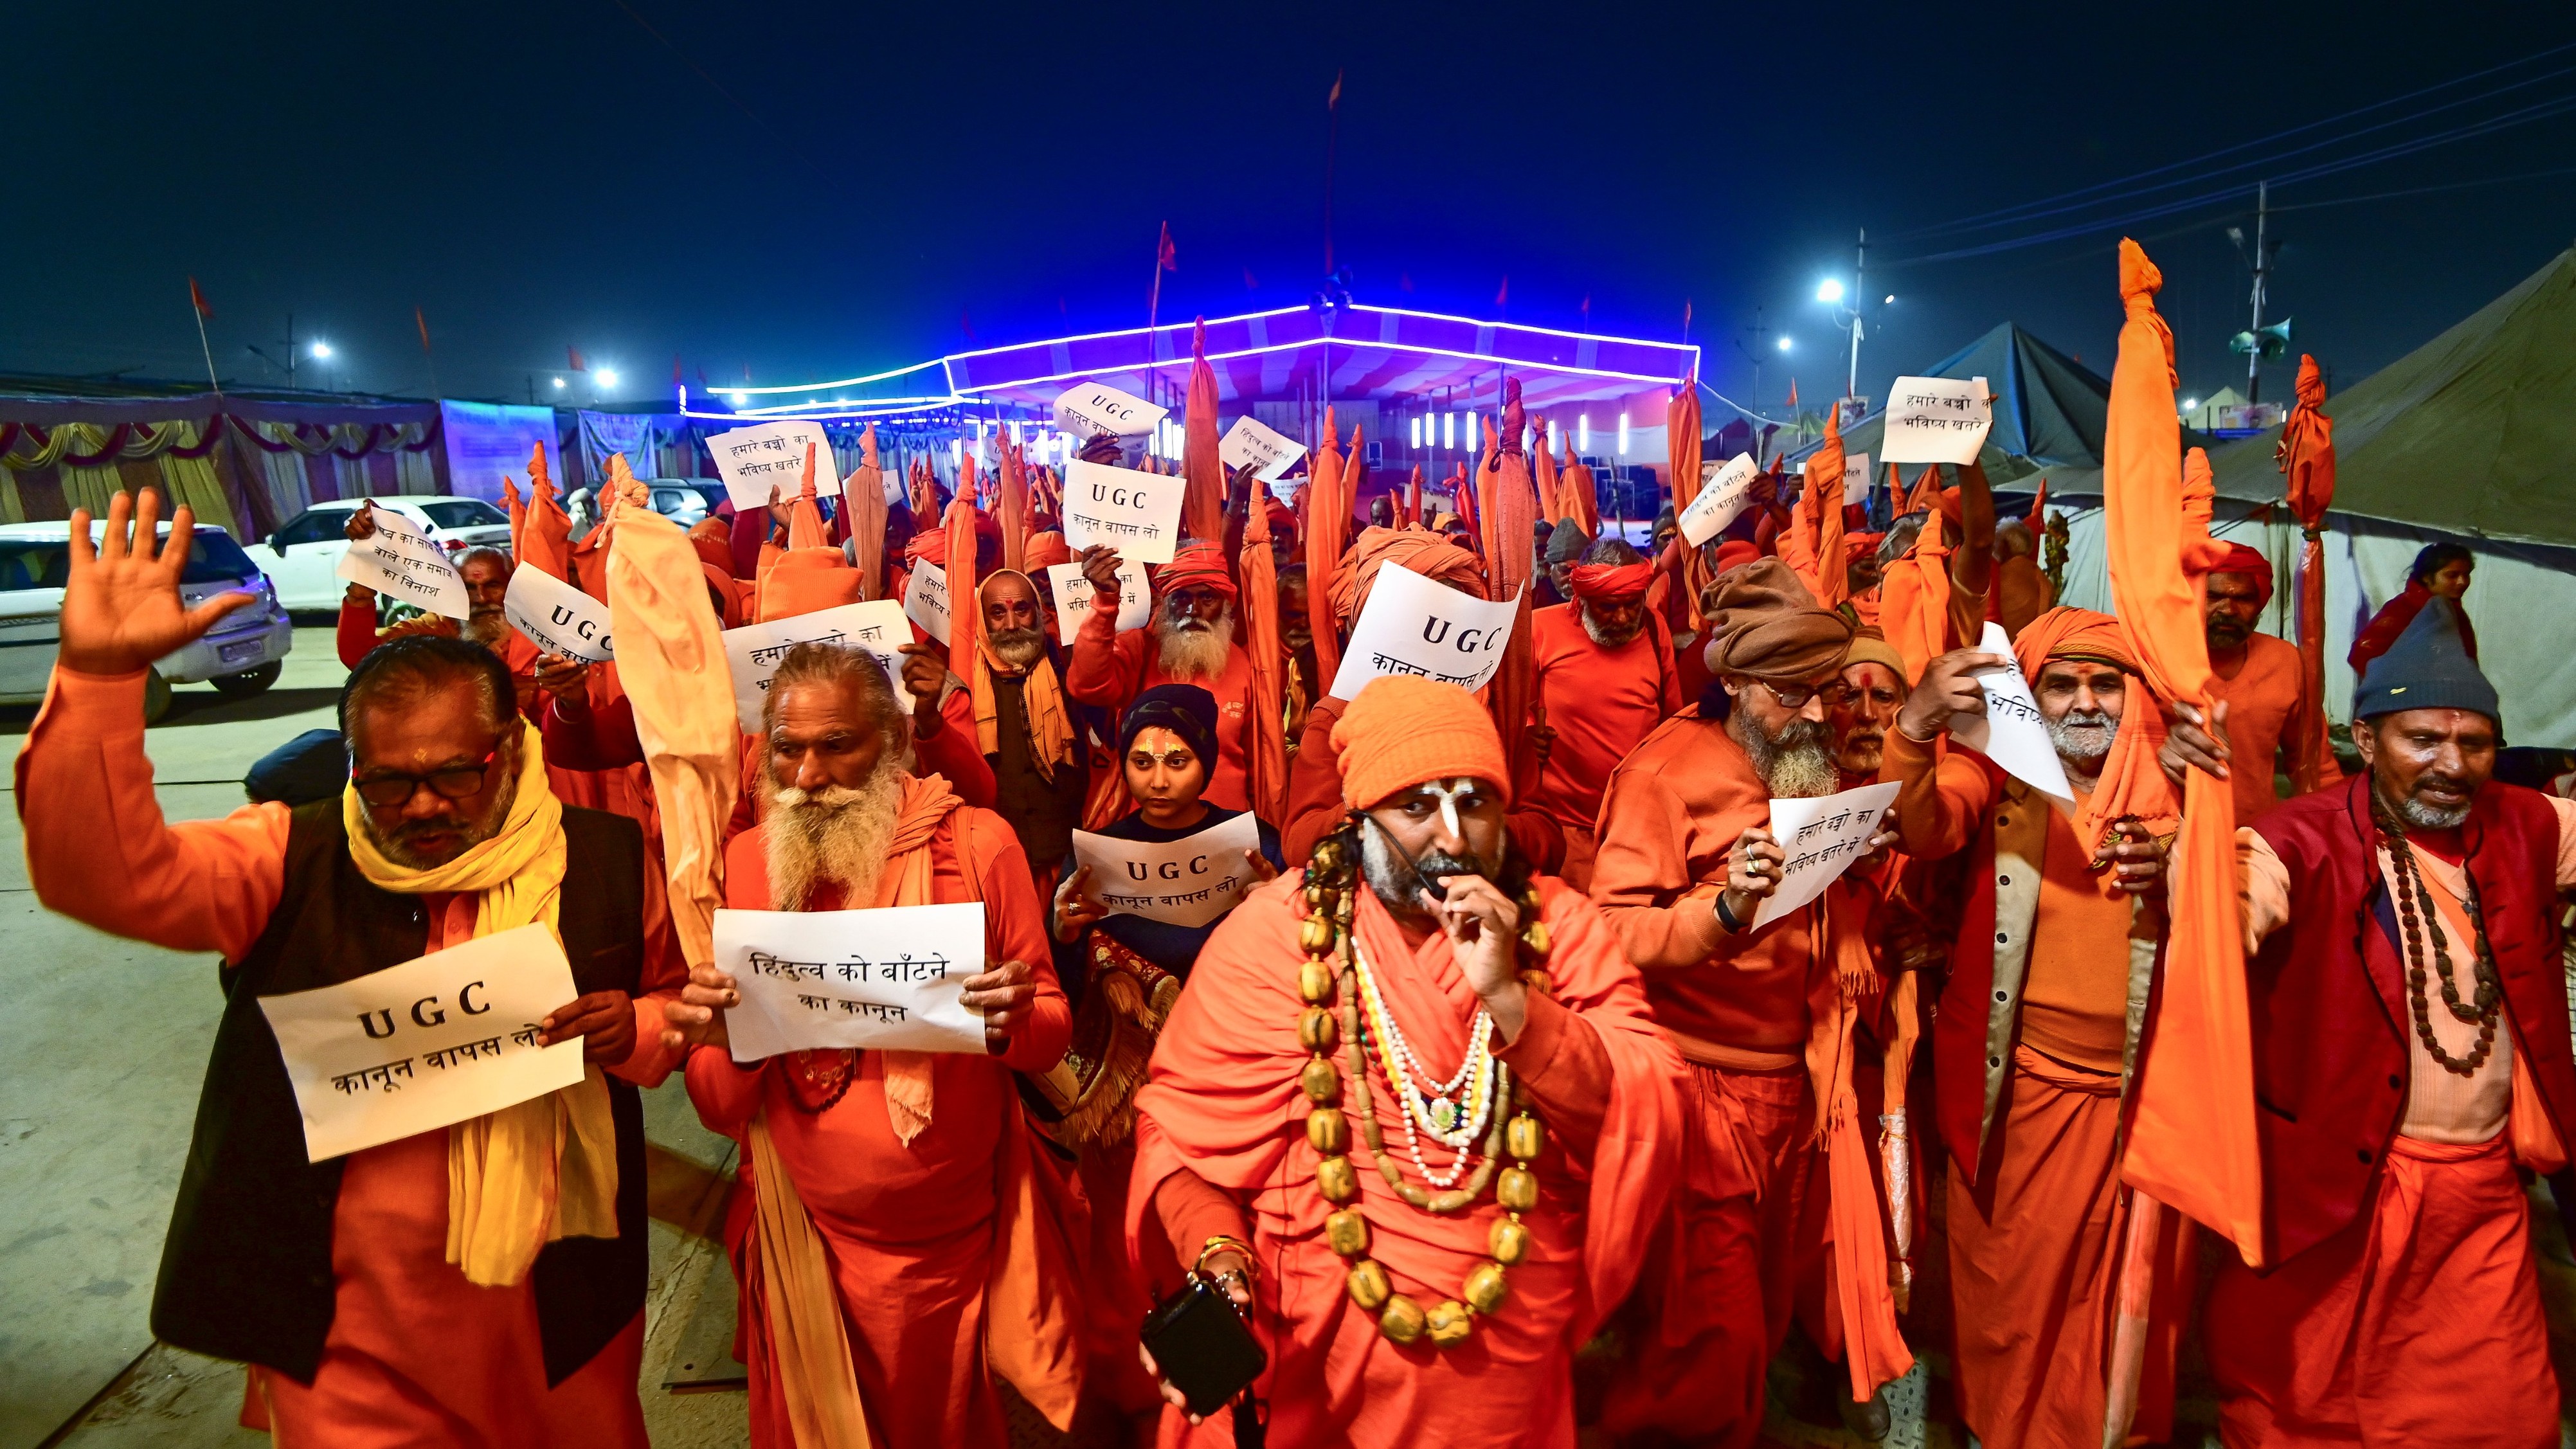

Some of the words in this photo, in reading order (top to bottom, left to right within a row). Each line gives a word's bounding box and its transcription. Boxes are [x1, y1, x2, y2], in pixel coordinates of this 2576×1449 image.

[1092, 395, 1133, 420] UGC
[1907, 392, 1939, 408] हमारे
[1064, 406, 1090, 427] कानून
[1904, 415, 1947, 430] भविष्य
[1952, 417, 1985, 431] खतरे
[730, 439, 760, 458] हमारे
[793, 435, 809, 445] का
[1243, 447, 1251, 456] का
[737, 463, 771, 477] भविष्य
[775, 455, 802, 470] खतरे
[1093, 484, 1146, 509] UGC
[1702, 507, 1715, 517] का
[1716, 494, 1740, 510] कानून
[399, 533, 415, 545] का
[1074, 514, 1101, 533] कानून
[1105, 521, 1139, 536] वापस
[1143, 524, 1160, 539] लो
[374, 546, 400, 562] वाले
[403, 557, 424, 570] एक
[383, 567, 398, 580] का
[400, 575, 440, 597] विनाश
[925, 575, 946, 595] हमारे
[919, 591, 945, 614] भविष्य
[1128, 592, 1136, 604] में
[519, 616, 557, 649] कानून
[858, 626, 883, 642] का
[1423, 615, 1502, 652] UGC
[1796, 816, 1827, 845] हमारे
[1857, 809, 1874, 825] का
[1126, 855, 1209, 881] UGC
[1785, 852, 1819, 876] भविष्य
[1820, 840, 1846, 862] खतरे
[1846, 836, 1860, 854] में
[1101, 893, 1153, 910] कानून
[1158, 888, 1210, 906] वापस
[1215, 876, 1239, 893] लो
[749, 951, 827, 982] हिंदुत्व
[836, 955, 872, 982] को
[880, 952, 950, 982] बाँटने
[356, 980, 491, 1040] UGC
[797, 994, 830, 1011] का
[838, 999, 908, 1025] कानून
[331, 1058, 413, 1095] कानून
[423, 1036, 503, 1070] वापस
